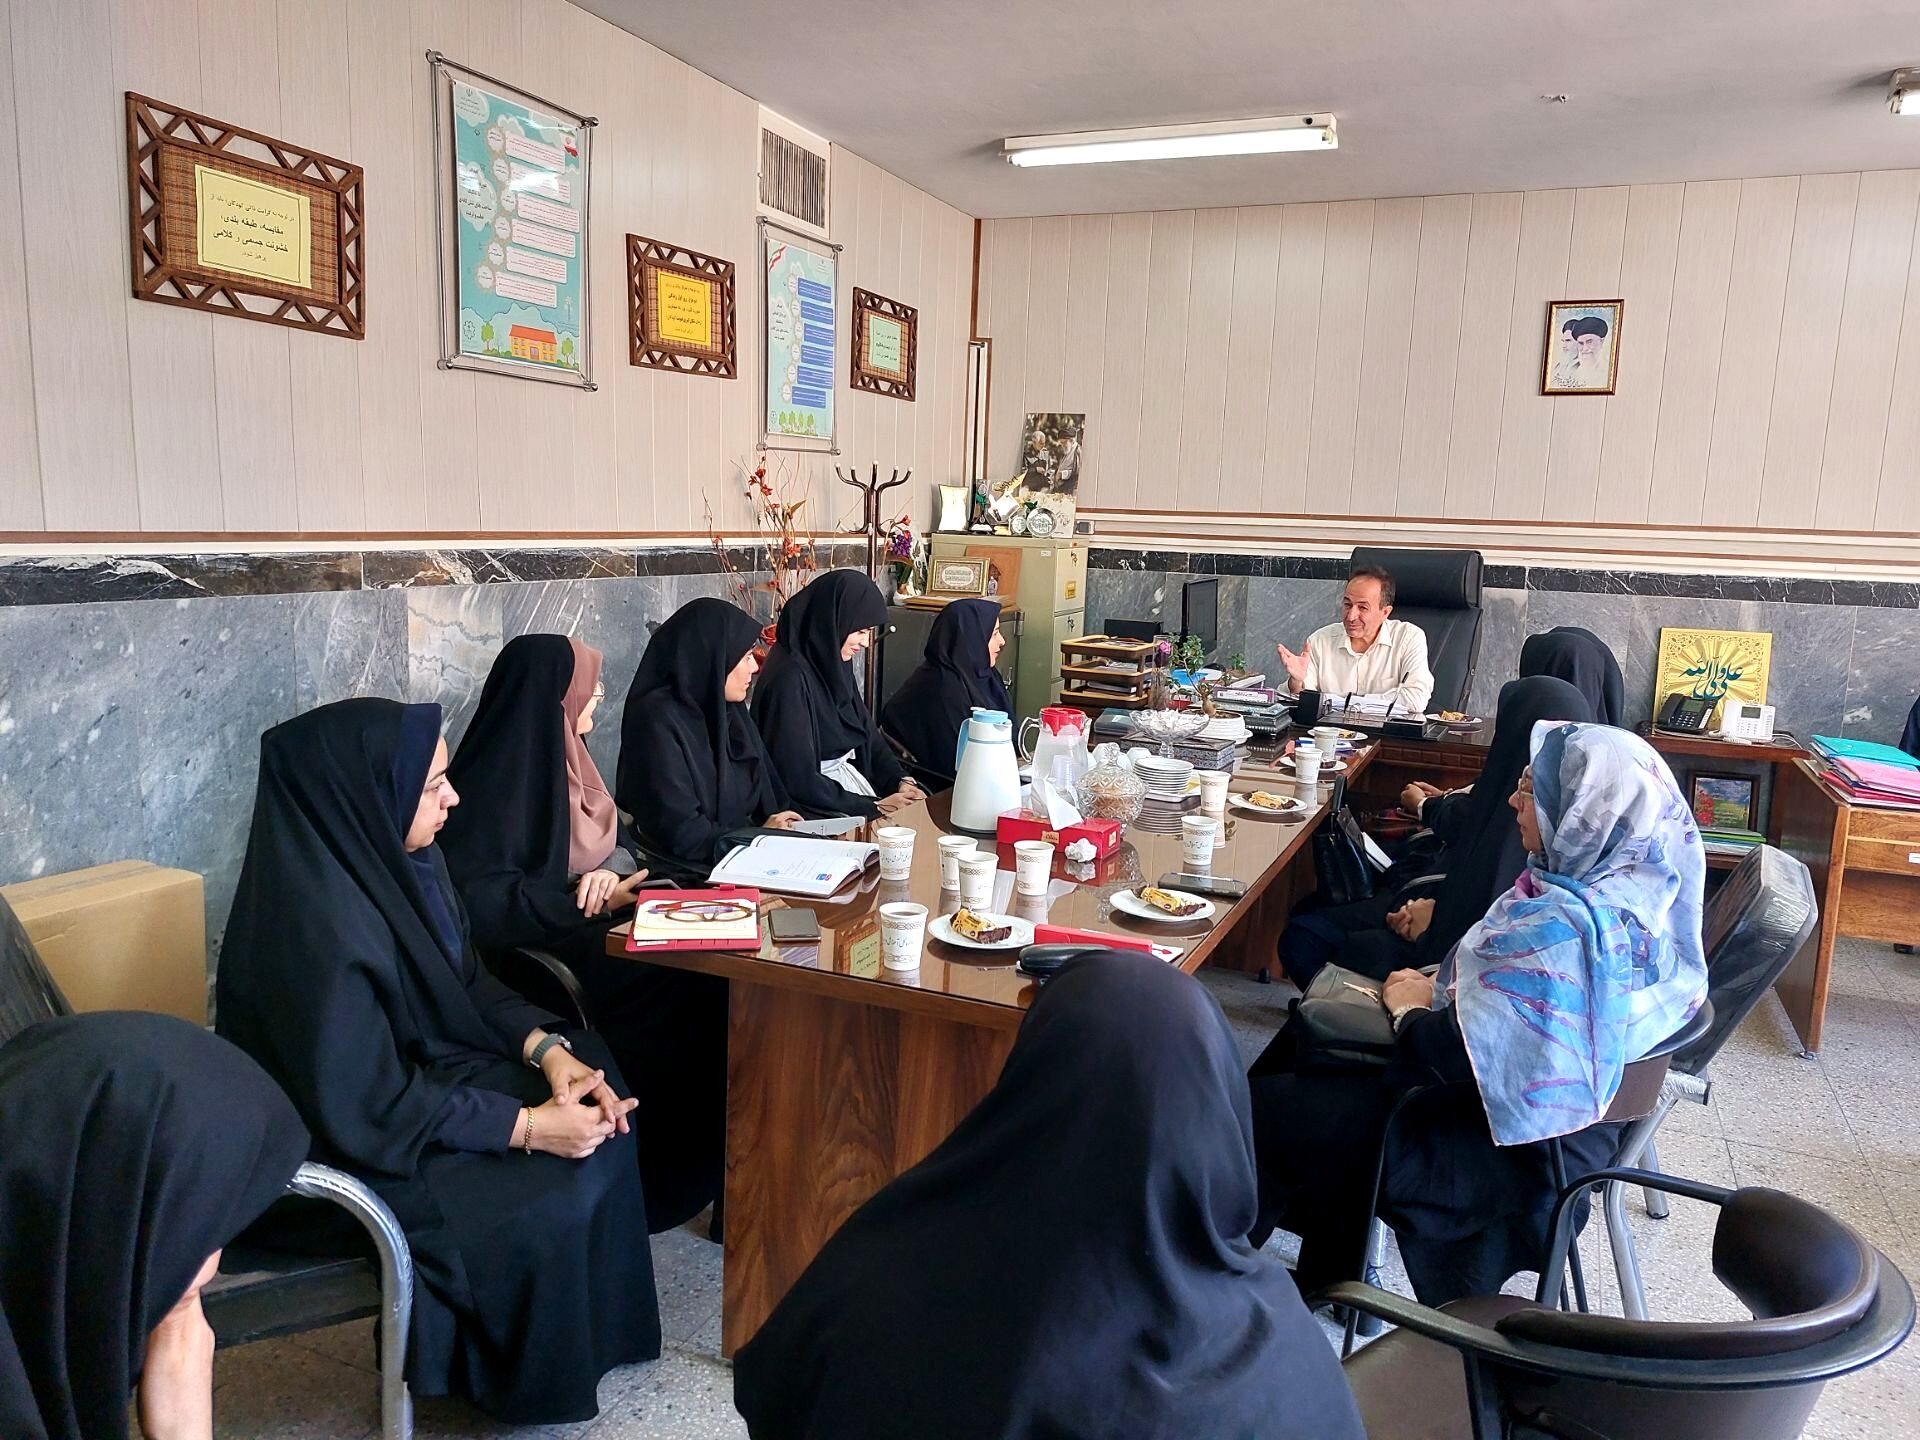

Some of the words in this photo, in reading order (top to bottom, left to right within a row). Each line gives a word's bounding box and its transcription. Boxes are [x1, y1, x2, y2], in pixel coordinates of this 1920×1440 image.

[257, 208, 271, 216] کرامت
[241, 217, 258, 228] طبقه
[213, 229, 233, 239] کلامی
[242, 237, 264, 247] جسمی
[265, 241, 289, 252] خشونت
[1678, 652, 1713, 679] الله
